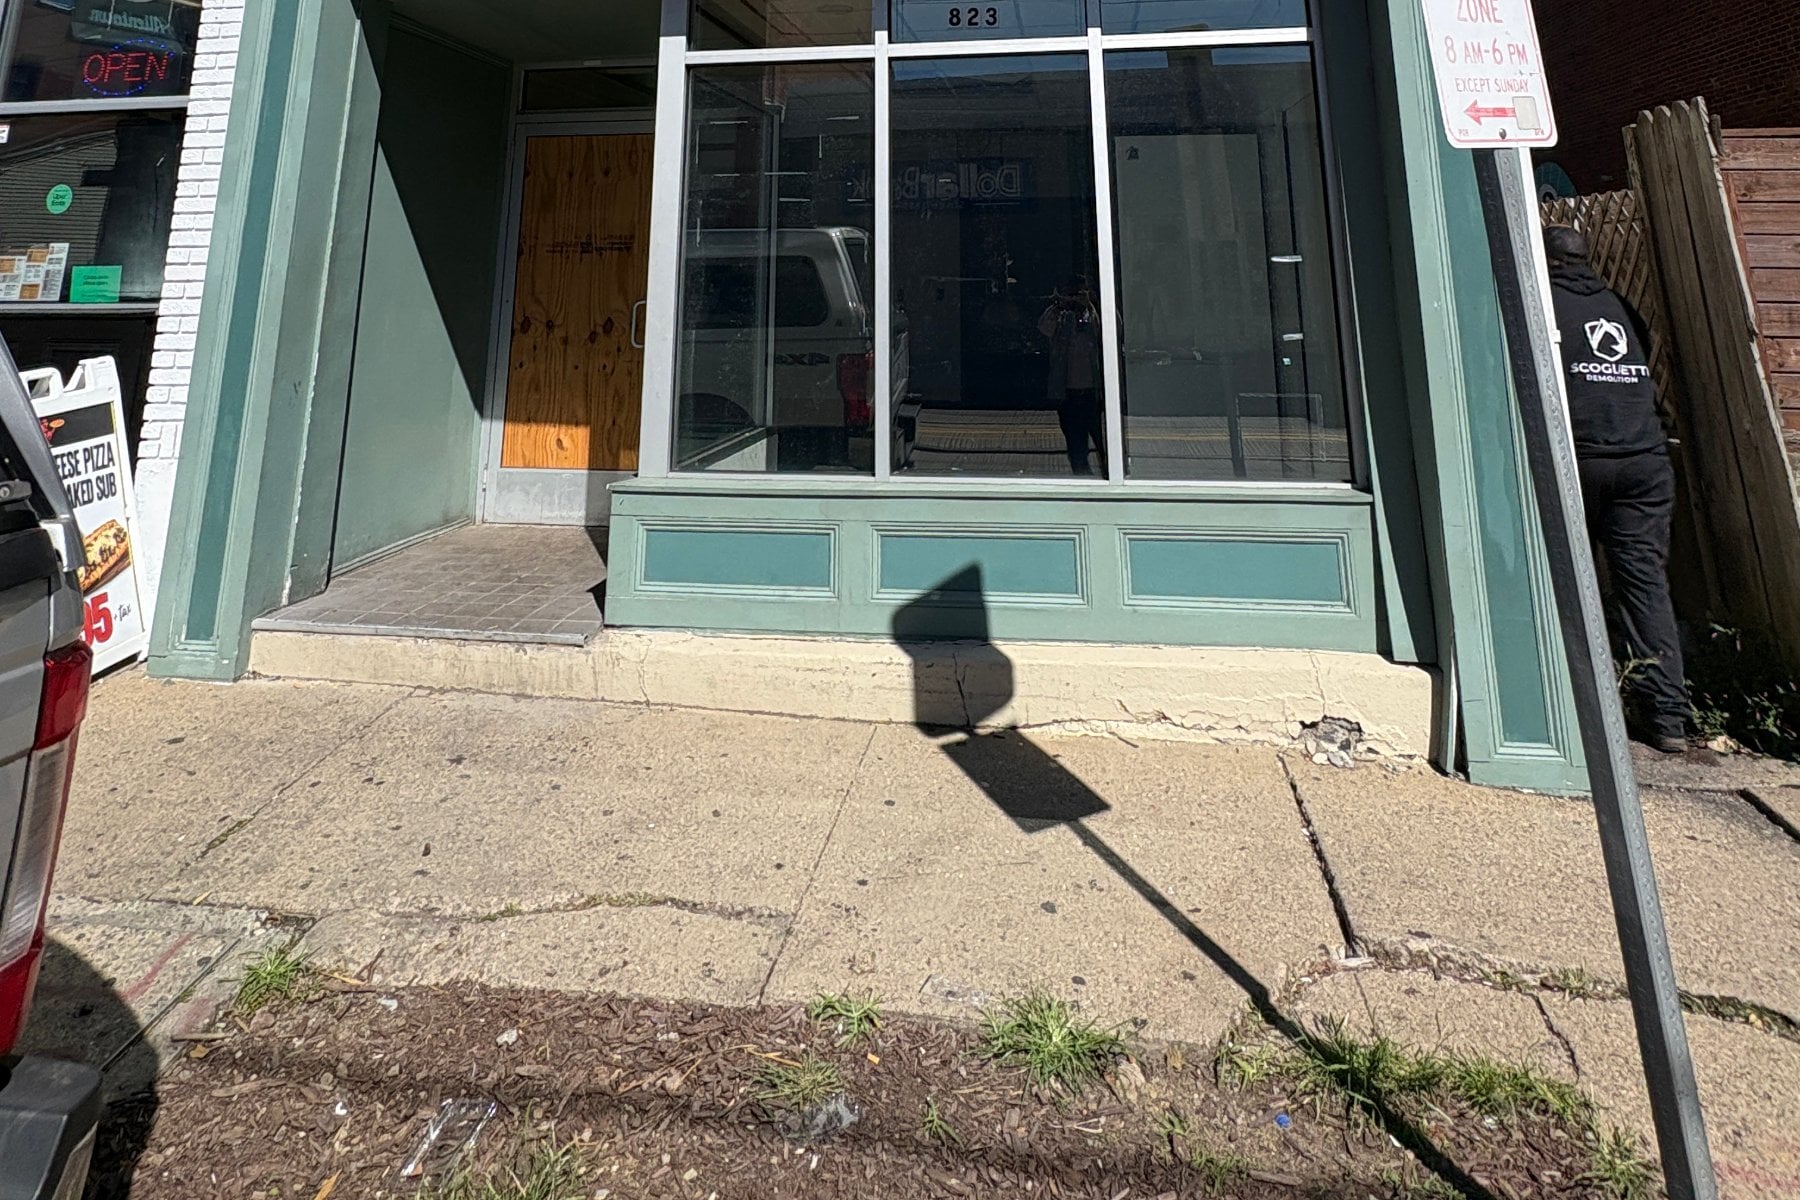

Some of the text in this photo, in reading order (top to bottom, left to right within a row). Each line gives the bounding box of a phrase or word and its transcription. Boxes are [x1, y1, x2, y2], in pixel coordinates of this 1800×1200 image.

[948, 7, 998, 27] 823
[1444, 35, 1457, 63] 8
[1507, 43, 1528, 66] PM
[82, 52, 168, 83] OPEN
[1455, 77, 1528, 93] EXCEPT SUNDAY
[1586, 374, 1639, 384] DEMOLITION
[83, 441, 115, 474] PIZZA
[95, 472, 117, 501] SUB
[118, 603, 132, 621] tax
